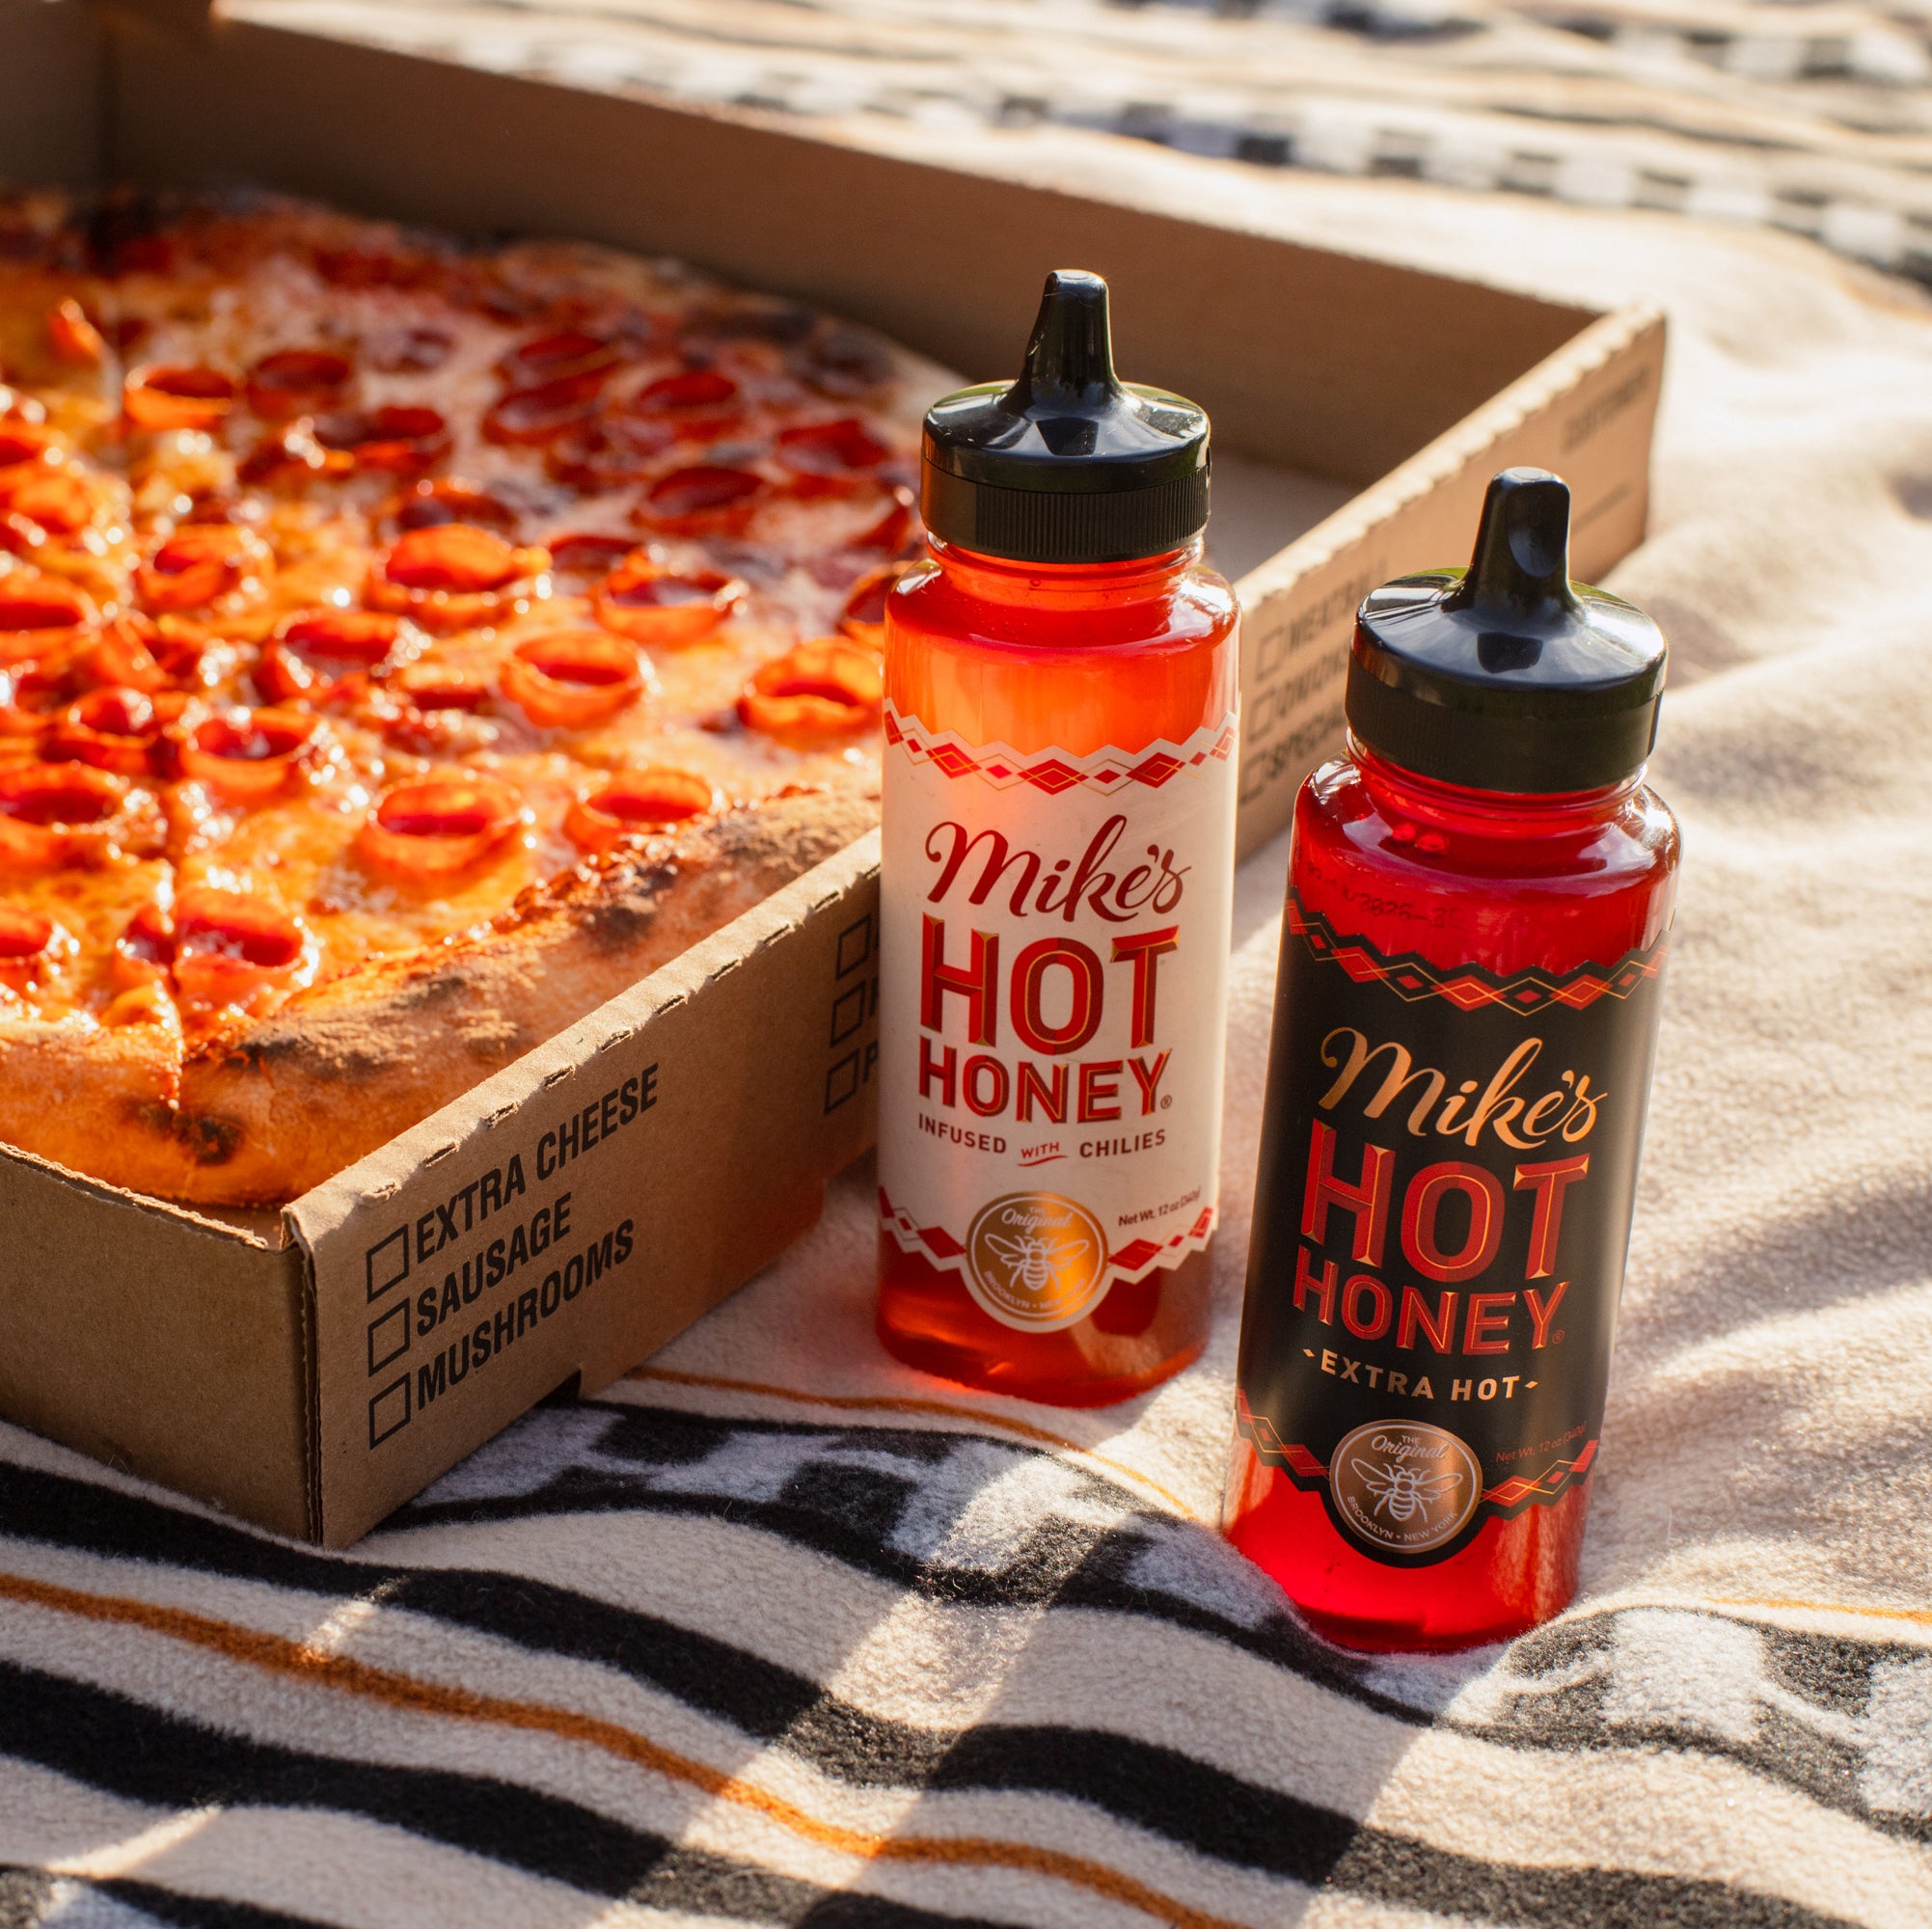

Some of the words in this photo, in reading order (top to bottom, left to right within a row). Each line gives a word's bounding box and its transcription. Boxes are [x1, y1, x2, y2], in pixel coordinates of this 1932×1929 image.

[925, 814, 1192, 923] Mike's
[920, 911, 1180, 1056] HOT
[1318, 1026, 1609, 1151] Mike's
[918, 1113, 1007, 1155] INFUSED
[1020, 1142, 1060, 1159] WITH
[1079, 1128, 1166, 1158] CHILIES
[416, 1153, 527, 1264] EXTRA
[536, 1062, 660, 1182] CHEESE
[1001, 1208, 1074, 1234] Original
[1118, 1213, 1137, 1227] Net
[1158, 1204, 1169, 1216] 12
[1300, 1117, 1591, 1283] HOT
[416, 1192, 572, 1337] SAUSAGE
[985, 1270, 1031, 1309] BROOKLYN
[418, 1218, 634, 1411] MUSHROOMS
[1320, 1348, 1434, 1400] EXTRA
[1451, 1375, 1520, 1401] HOT
[1371, 1434, 1449, 1463] Original
[1401, 1435, 1422, 1445] THE
[1496, 1452, 1515, 1462] Net
[1538, 1440, 1550, 1453] 12
[1347, 1496, 1394, 1539] BROOKLYN
[1403, 1531, 1429, 1541] NEW
[1432, 1511, 1458, 1534] YORK
